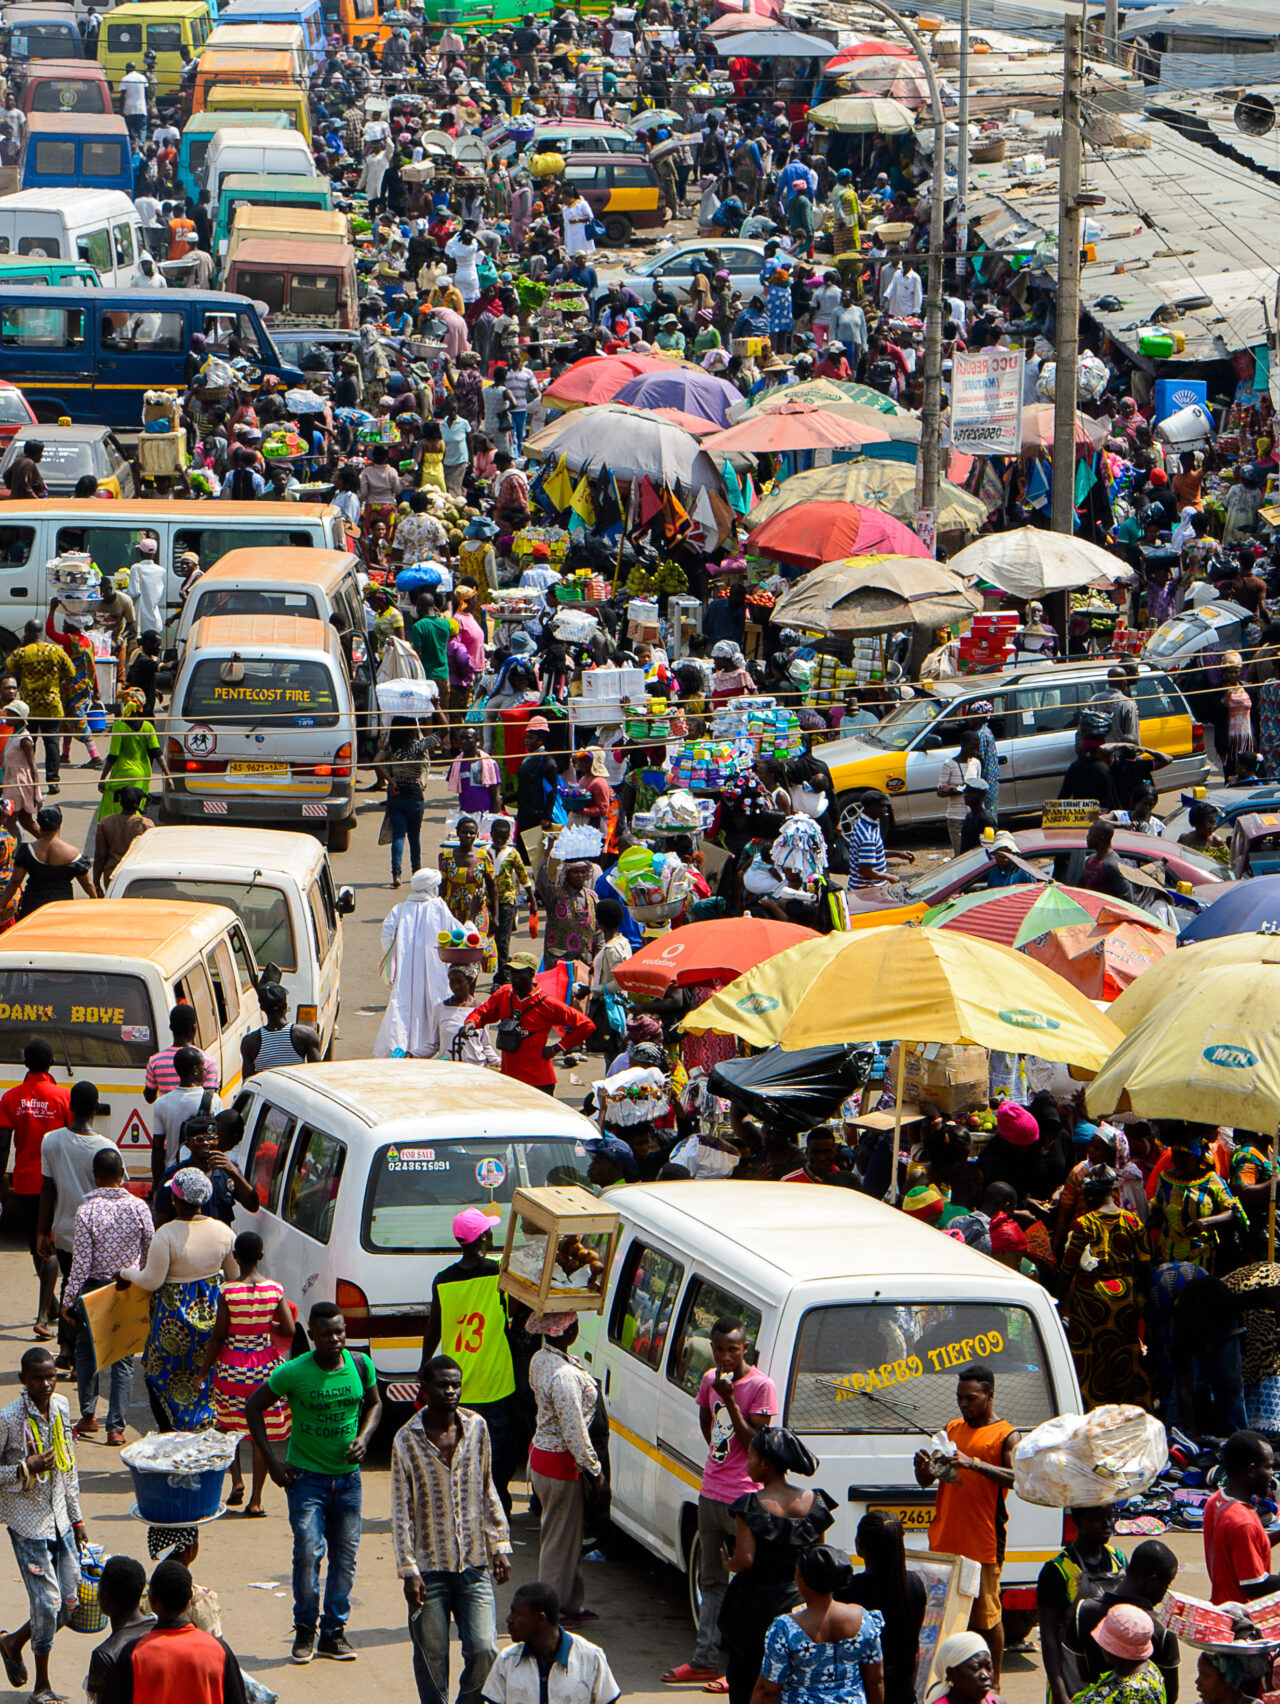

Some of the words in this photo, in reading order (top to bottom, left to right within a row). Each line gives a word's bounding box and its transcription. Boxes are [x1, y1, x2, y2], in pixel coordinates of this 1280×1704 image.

[214, 687, 283, 701] PENTECOST
[285, 690, 311, 702] FIRE
[1212, 1047, 1250, 1065] MTN
[402, 1151, 416, 1160] FOR
[417, 1151, 433, 1160] SALE
[455, 1312, 486, 1353] 13
[309, 1385, 352, 1400] CHACUN
[317, 1411, 347, 1423] CHEZ
